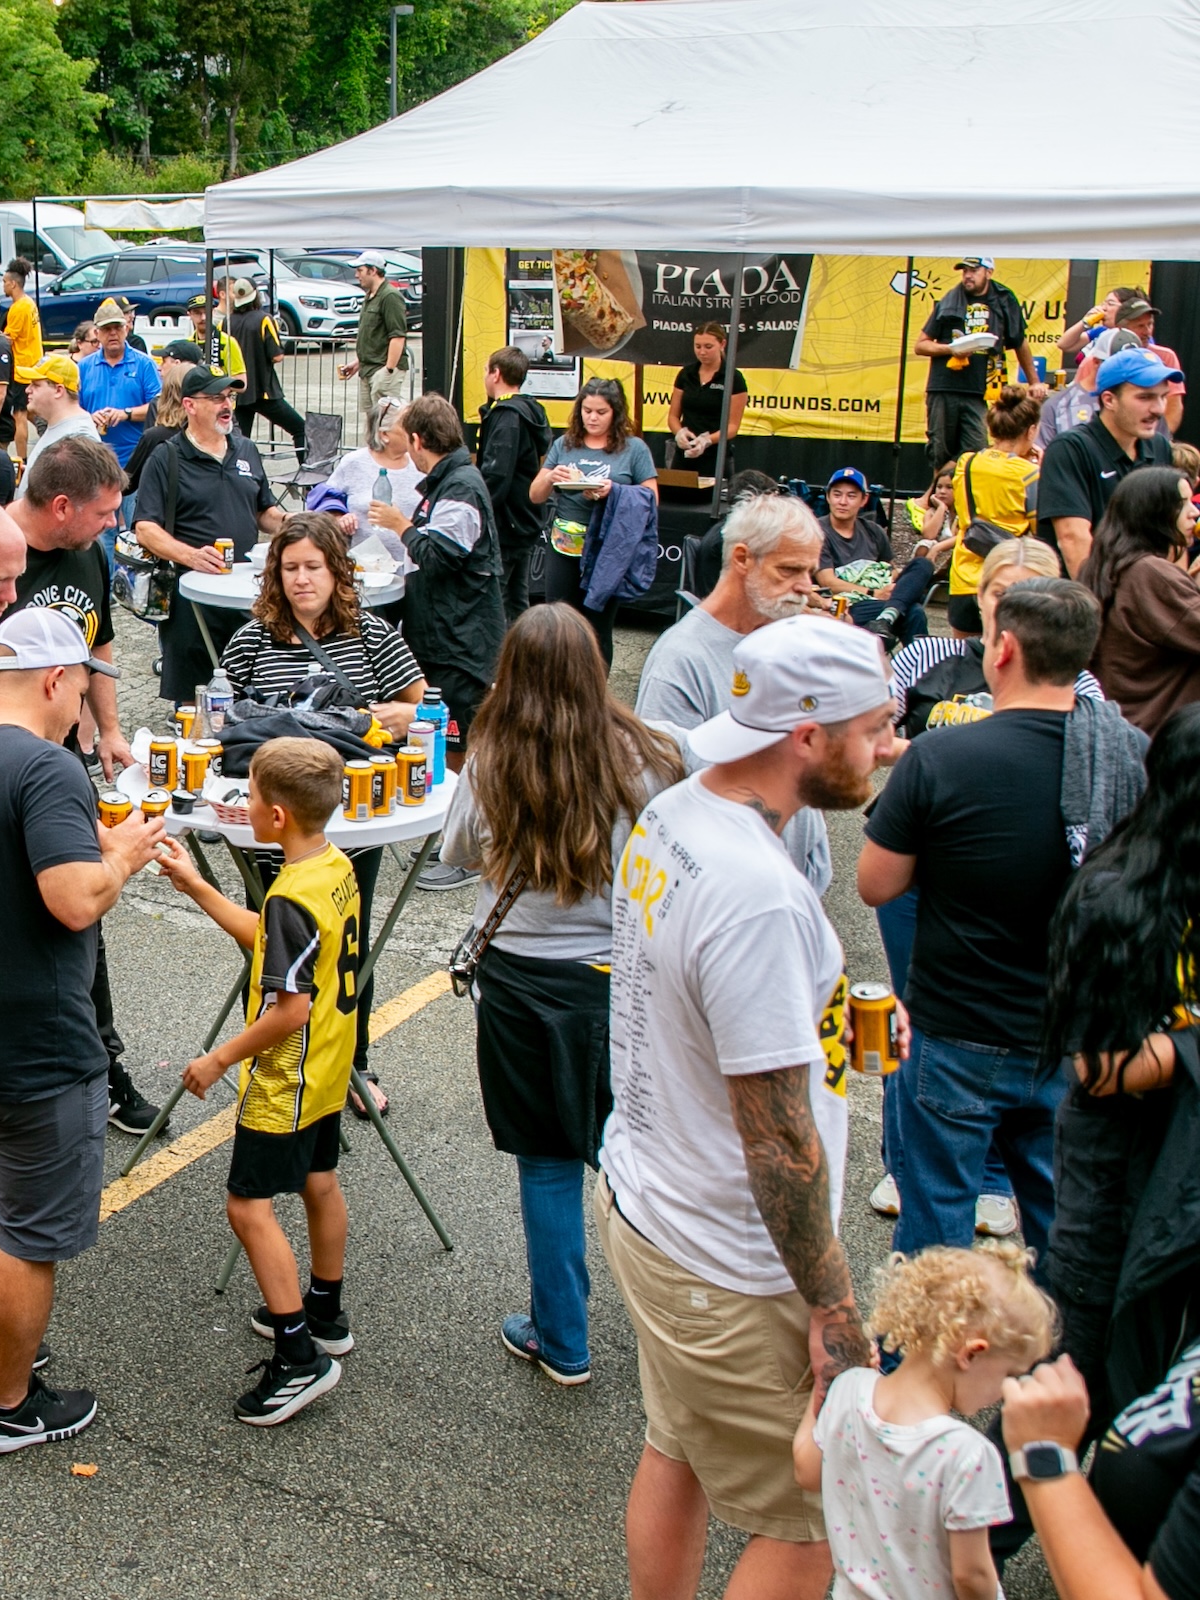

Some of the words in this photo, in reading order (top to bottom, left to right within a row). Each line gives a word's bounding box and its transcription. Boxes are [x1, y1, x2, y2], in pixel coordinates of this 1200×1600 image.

[518, 260, 534, 269] GET
[653, 260, 800, 297] PIADA
[652, 293, 702, 308] ITALIAN
[760, 291, 801, 305] FOOD
[653, 320, 693, 332] PIADAS
[757, 320, 799, 331] SALADS
[64, 585, 94, 611] CITY
[151, 754, 167, 769] IC
[411, 765, 426, 780] IC
